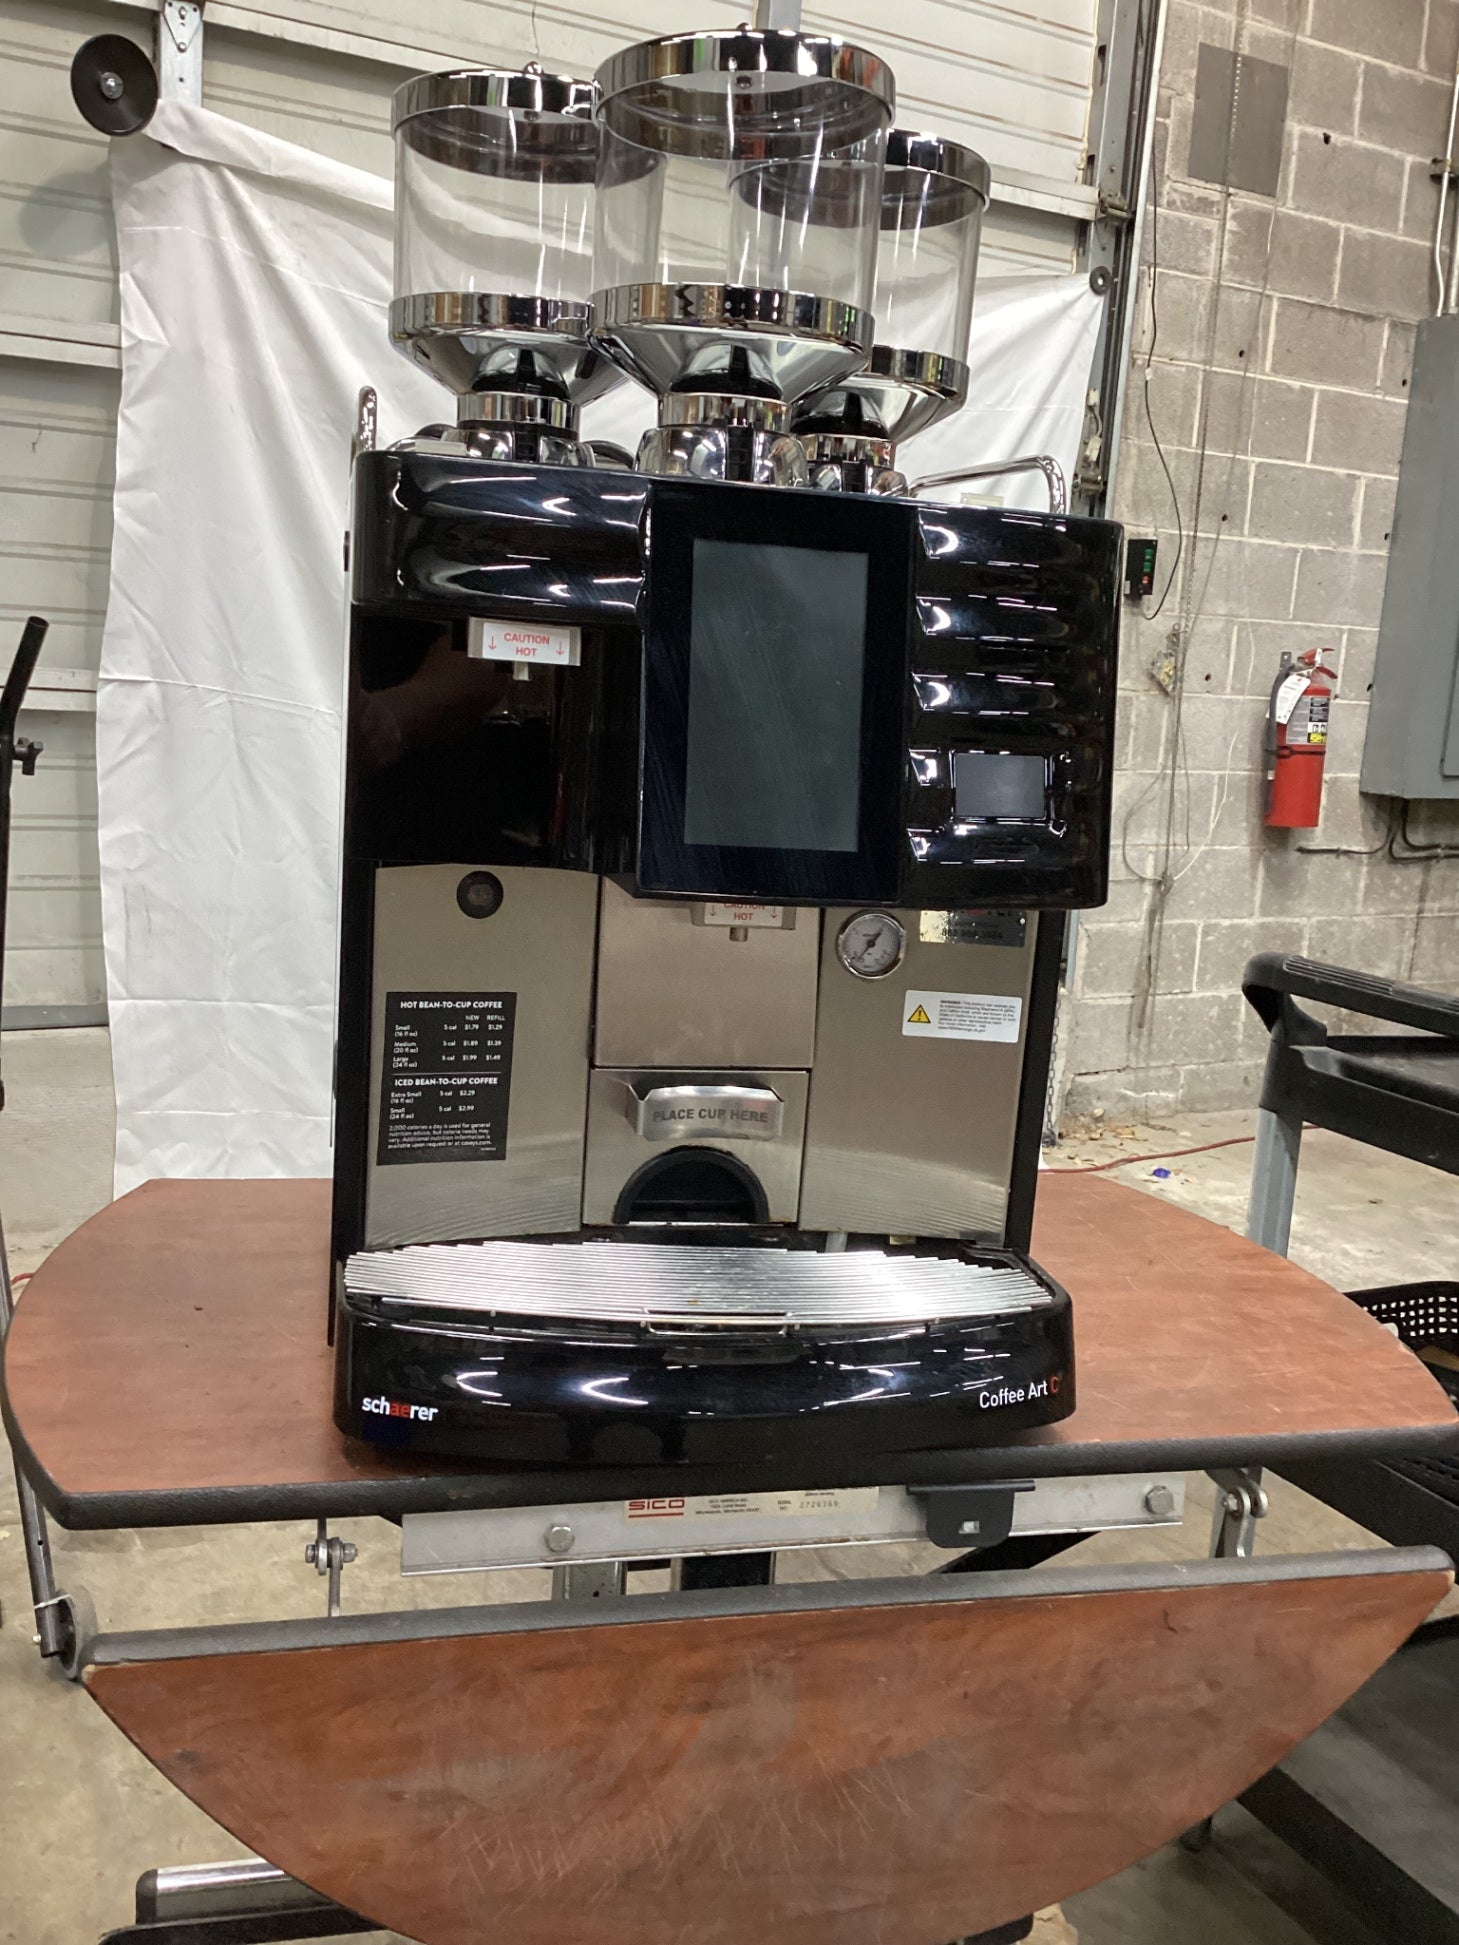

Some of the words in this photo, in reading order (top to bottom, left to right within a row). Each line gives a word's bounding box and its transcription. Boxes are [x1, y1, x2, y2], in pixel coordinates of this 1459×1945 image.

[504, 632, 550, 645] CAUTION
[515, 646, 538, 656] HOT
[734, 912, 753, 920] HOT
[415, 1078, 468, 1086] BEAN-TO-CUP
[652, 1108, 694, 1121] PLACE
[698, 1108, 726, 1119] CUP
[730, 1110, 768, 1122] HERE
[980, 1388, 1025, 1408] Coffee
[1028, 1380, 1048, 1399] Art
[362, 1396, 438, 1421] schaerer
[628, 1499, 685, 1511] SICO
